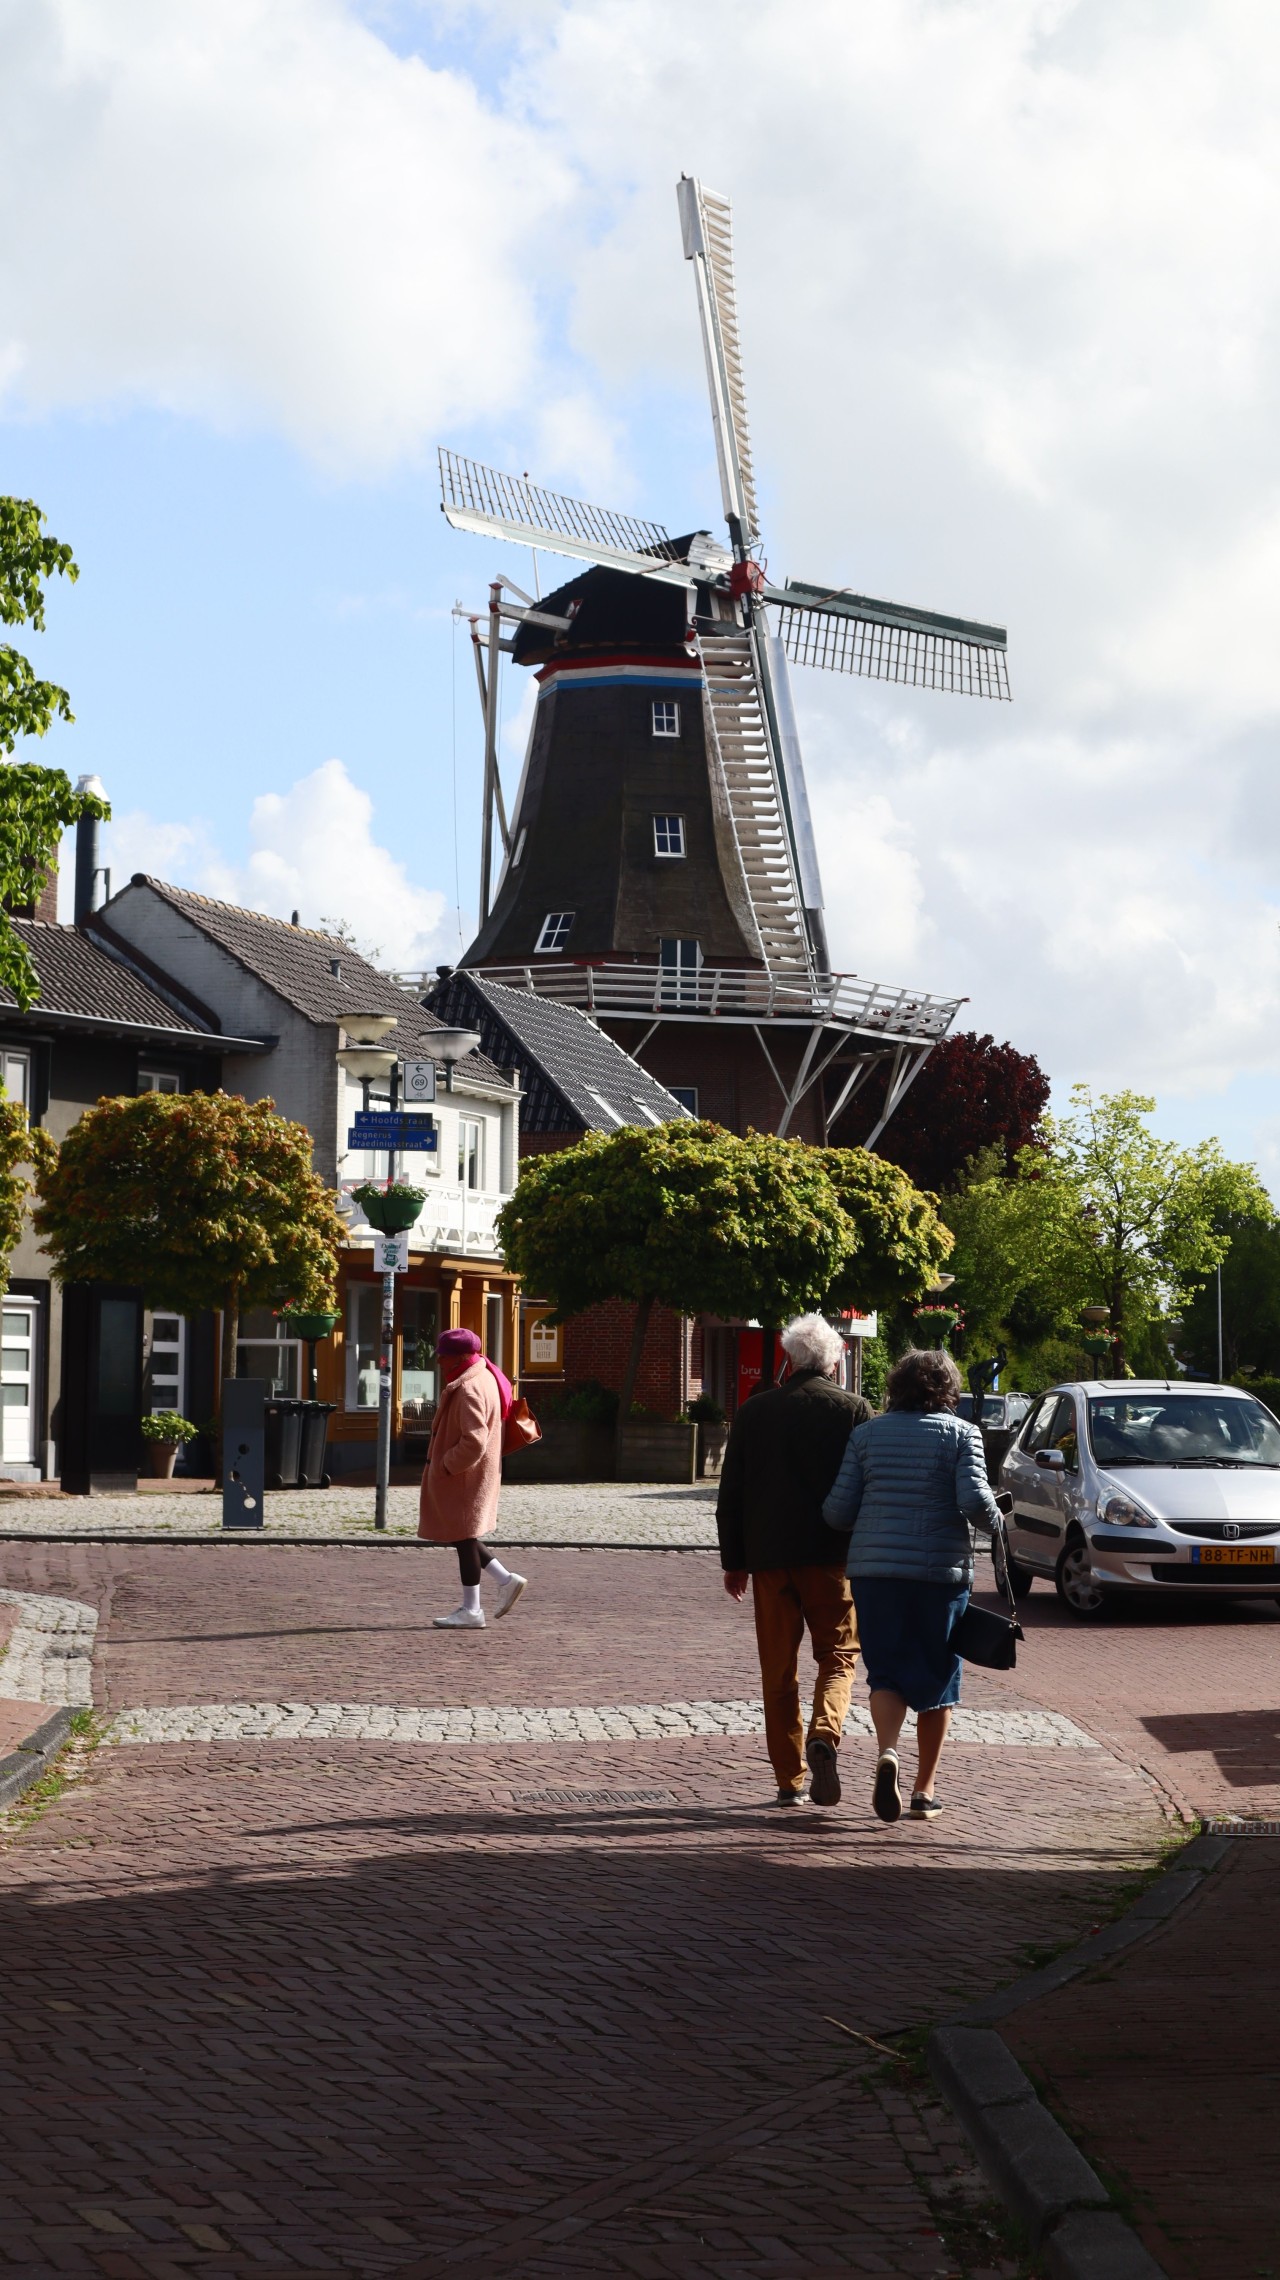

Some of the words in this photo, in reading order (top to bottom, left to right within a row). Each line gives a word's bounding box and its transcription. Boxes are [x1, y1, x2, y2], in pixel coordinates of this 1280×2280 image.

[414, 1079, 425, 1087] 69
[352, 1131, 392, 1140] Regnerus
[351, 1139, 423, 1149] Praediniusstraat
[740, 1364, 762, 1375] bru
[1204, 1549, 1269, 1562] 88-TF-NH
